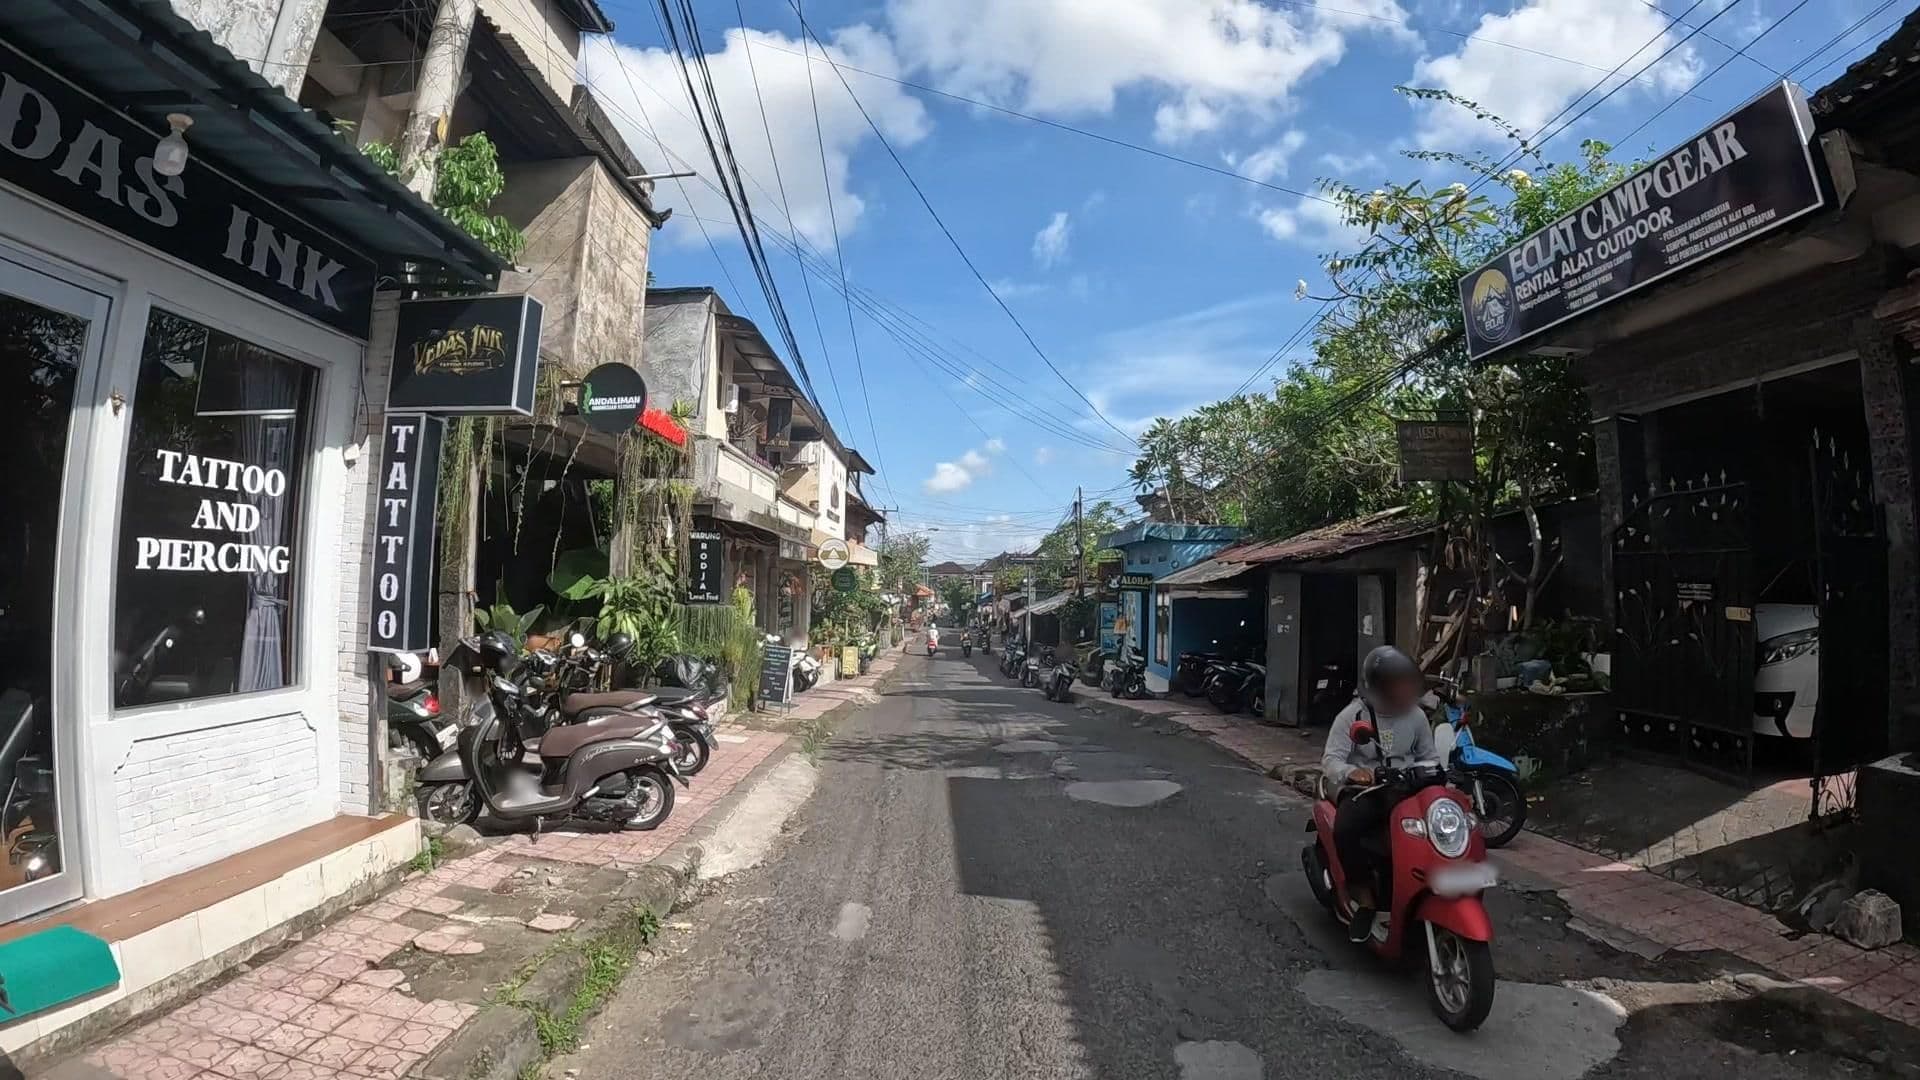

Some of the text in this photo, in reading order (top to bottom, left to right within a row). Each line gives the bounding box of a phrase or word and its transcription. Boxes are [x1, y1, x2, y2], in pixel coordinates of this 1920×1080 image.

[1508, 121, 1748, 282] ECLAT CAMPGEAR
[222, 204, 348, 312] INK
[1514, 267, 1559, 303] RENTAL
[1561, 247, 1594, 279] ALAT
[1597, 206, 1674, 260] OUTDOOR
[589, 396, 640, 406] ANDALIMAN
[157, 449, 286, 498] TATTOO
[192, 500, 260, 533] AND
[377, 425, 414, 640] TATTOO
[690, 532, 720, 540] WARUNG
[136, 537, 290, 574] PIERCING
